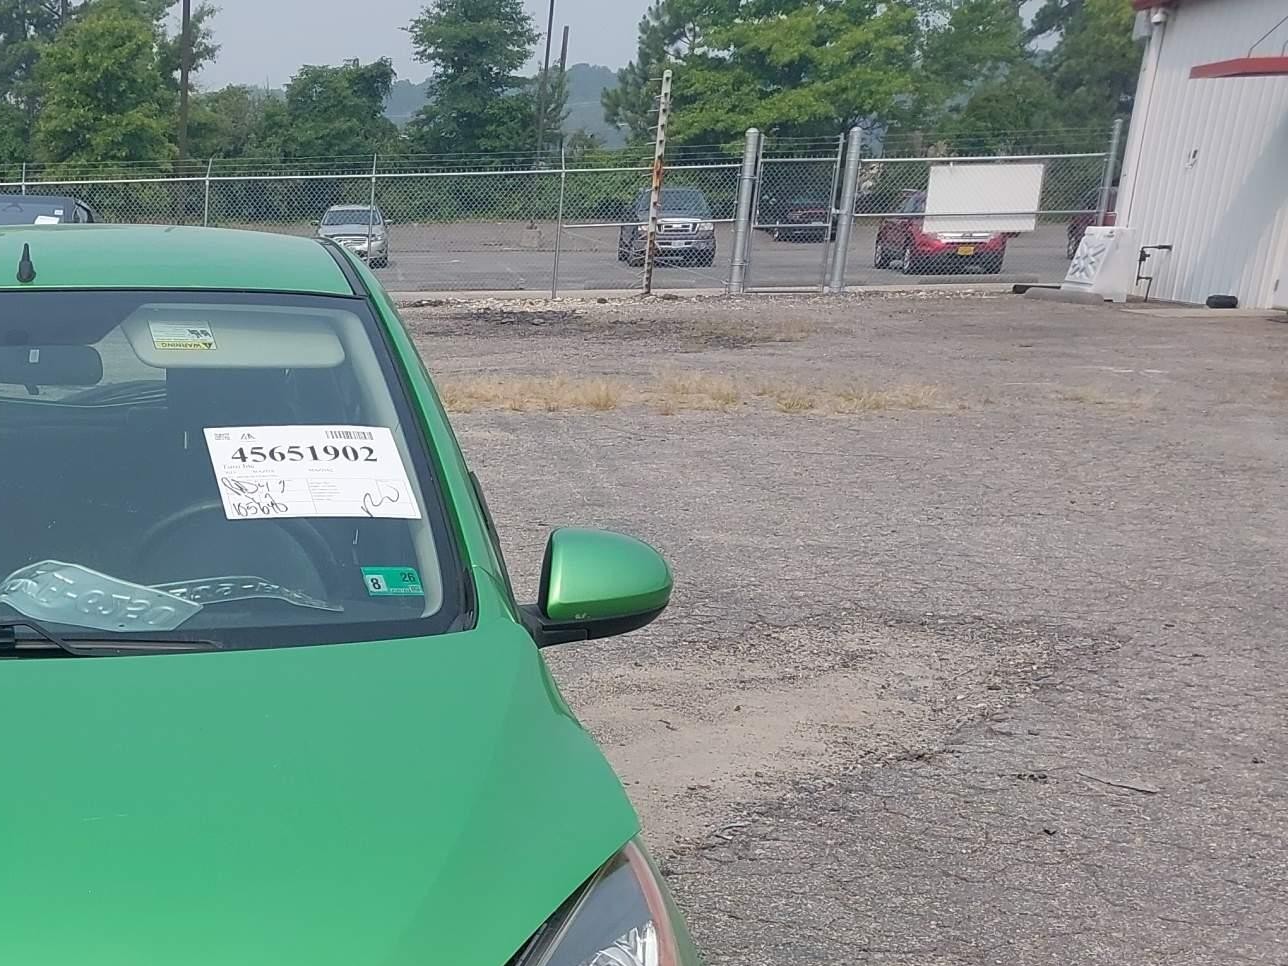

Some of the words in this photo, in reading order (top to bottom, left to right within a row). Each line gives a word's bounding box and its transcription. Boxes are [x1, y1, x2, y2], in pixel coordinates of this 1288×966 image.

[231, 444, 378, 463] 45651902
[370, 577, 382, 590] 8
[400, 572, 416, 583] 26
